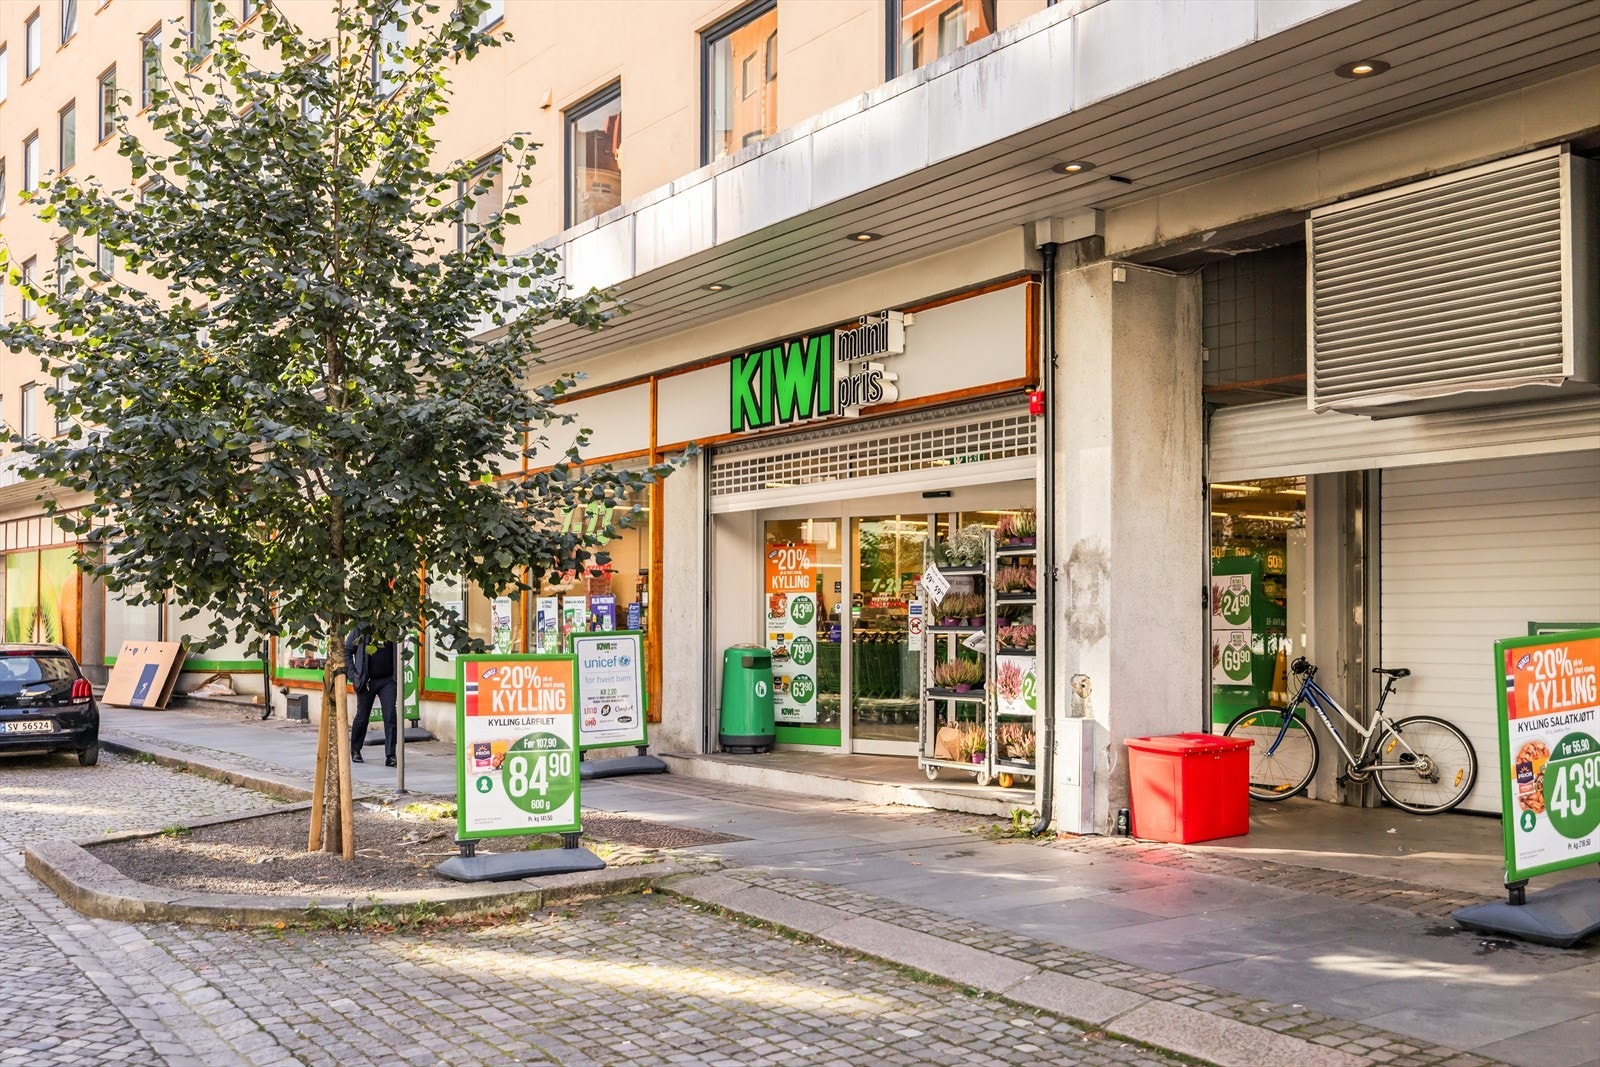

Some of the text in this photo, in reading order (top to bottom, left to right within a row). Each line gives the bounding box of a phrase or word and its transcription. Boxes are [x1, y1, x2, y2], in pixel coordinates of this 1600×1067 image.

[838, 310, 889, 362] mini
[730, 330, 834, 433] KIWI
[838, 361, 884, 417] pris
[772, 549, 810, 570] -20%
[772, 575, 810, 589] KYLLING
[871, 578, 902, 593] 7-23
[584, 655, 617, 669] unicef
[1527, 647, 1573, 681] -20%
[492, 665, 542, 689] -20%
[585, 676, 595, 684] for
[492, 688, 567, 713] KYLLING
[1528, 673, 1597, 712] KYLLING
[7, 721, 49, 731] SV 56524
[488, 717, 555, 727] KYLLING LÅRFILET
[1517, 710, 1595, 733] KYLLING SALATKJØTT
[523, 737, 557, 749] Før 107,90
[1562, 738, 1590, 755] Før 55,90
[531, 799, 551, 810] 600 g
